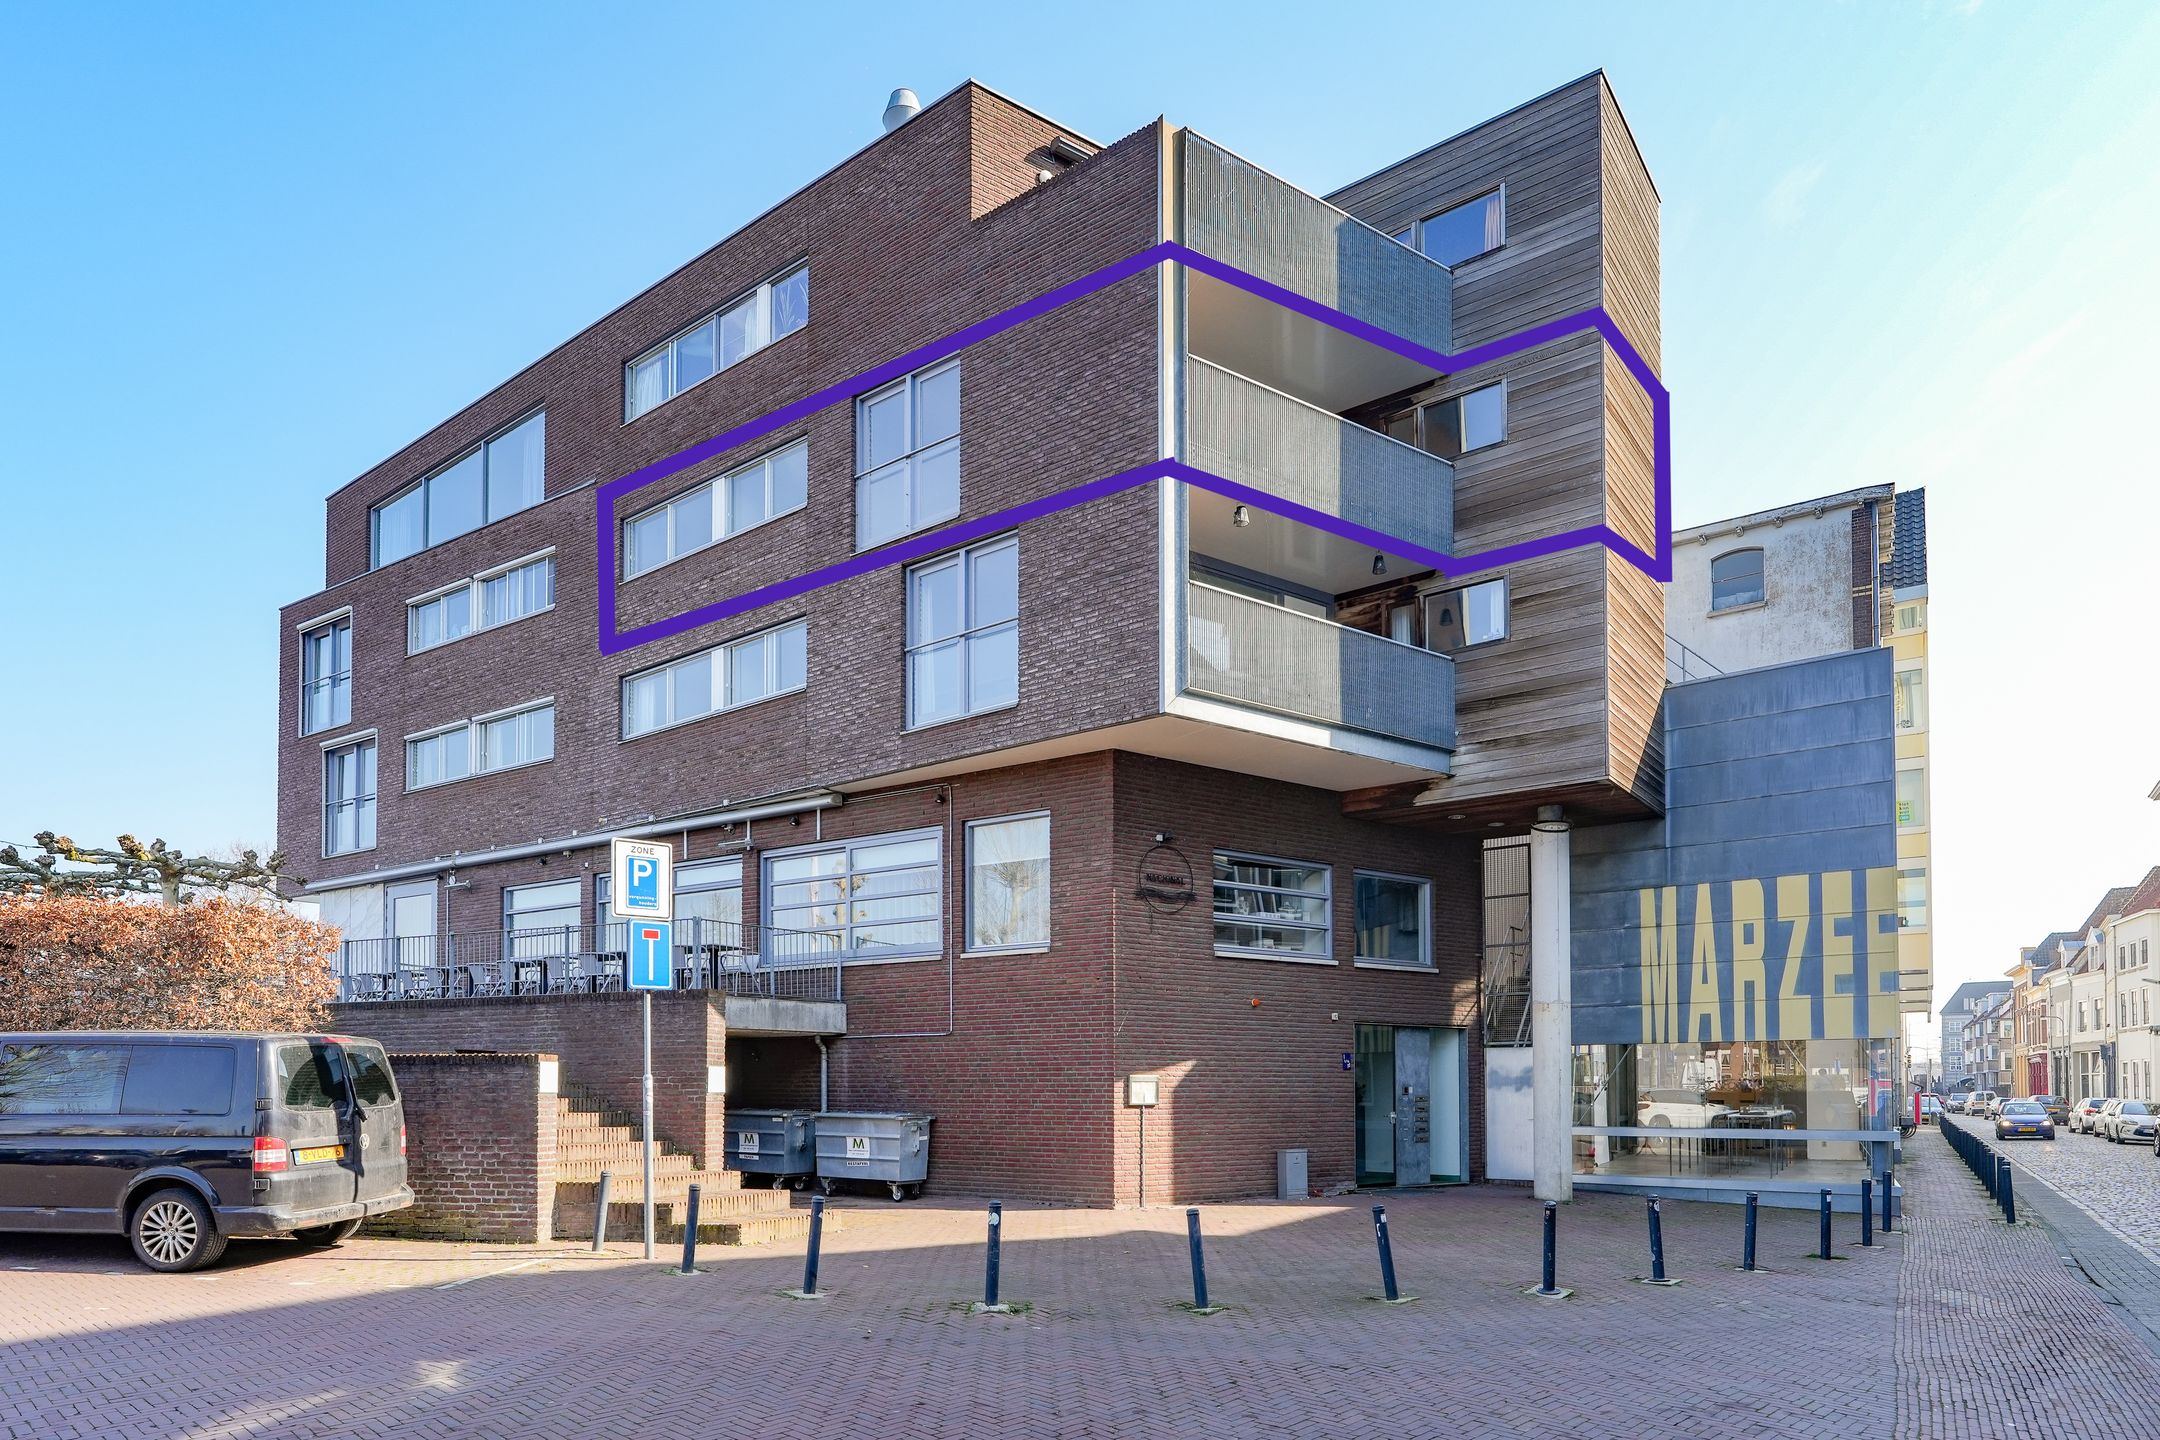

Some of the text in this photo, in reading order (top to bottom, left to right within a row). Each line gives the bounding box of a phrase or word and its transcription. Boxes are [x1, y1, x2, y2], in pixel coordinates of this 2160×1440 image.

[631, 845, 655, 855] ZONE
[633, 859, 652, 887] P
[1639, 866, 1900, 1043] MARZEE
[744, 1134, 754, 1144] M
[853, 1138, 864, 1149] M
